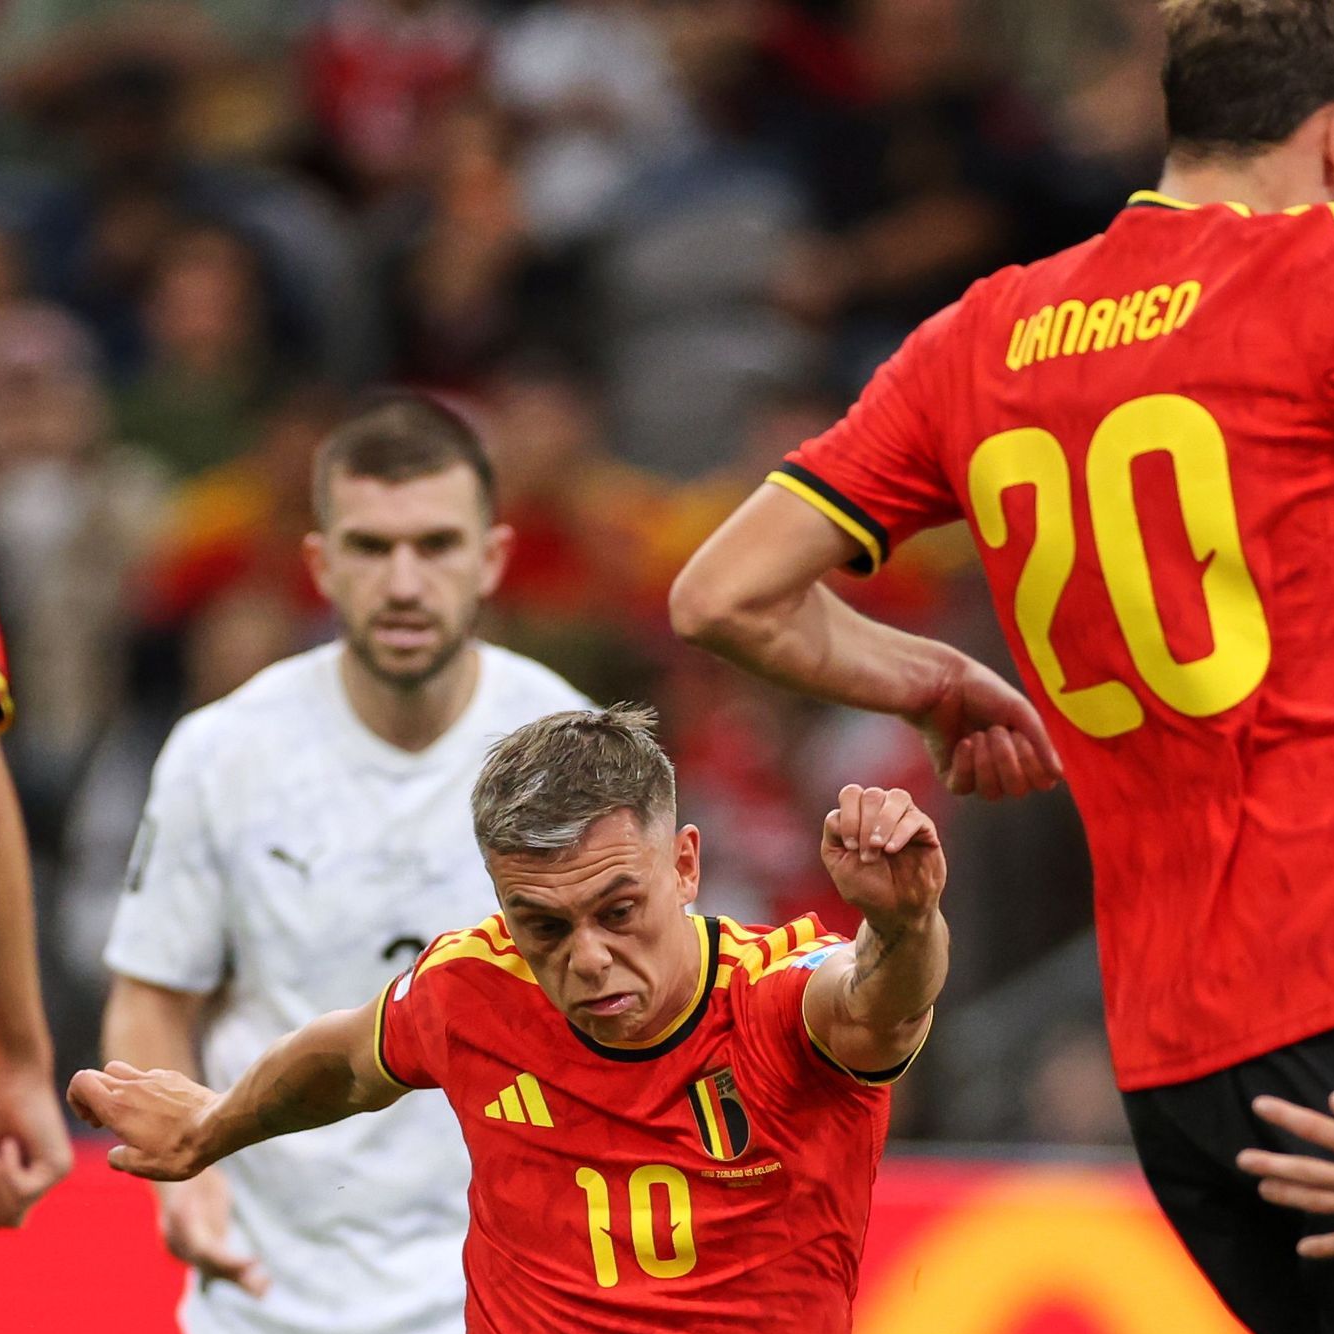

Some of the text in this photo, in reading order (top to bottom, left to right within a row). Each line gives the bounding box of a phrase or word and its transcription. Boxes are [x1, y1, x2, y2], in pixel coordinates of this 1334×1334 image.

[1005, 279, 1202, 371] VANAKEN
[968, 393, 1272, 739] 20
[574, 1164, 698, 1289] 10
